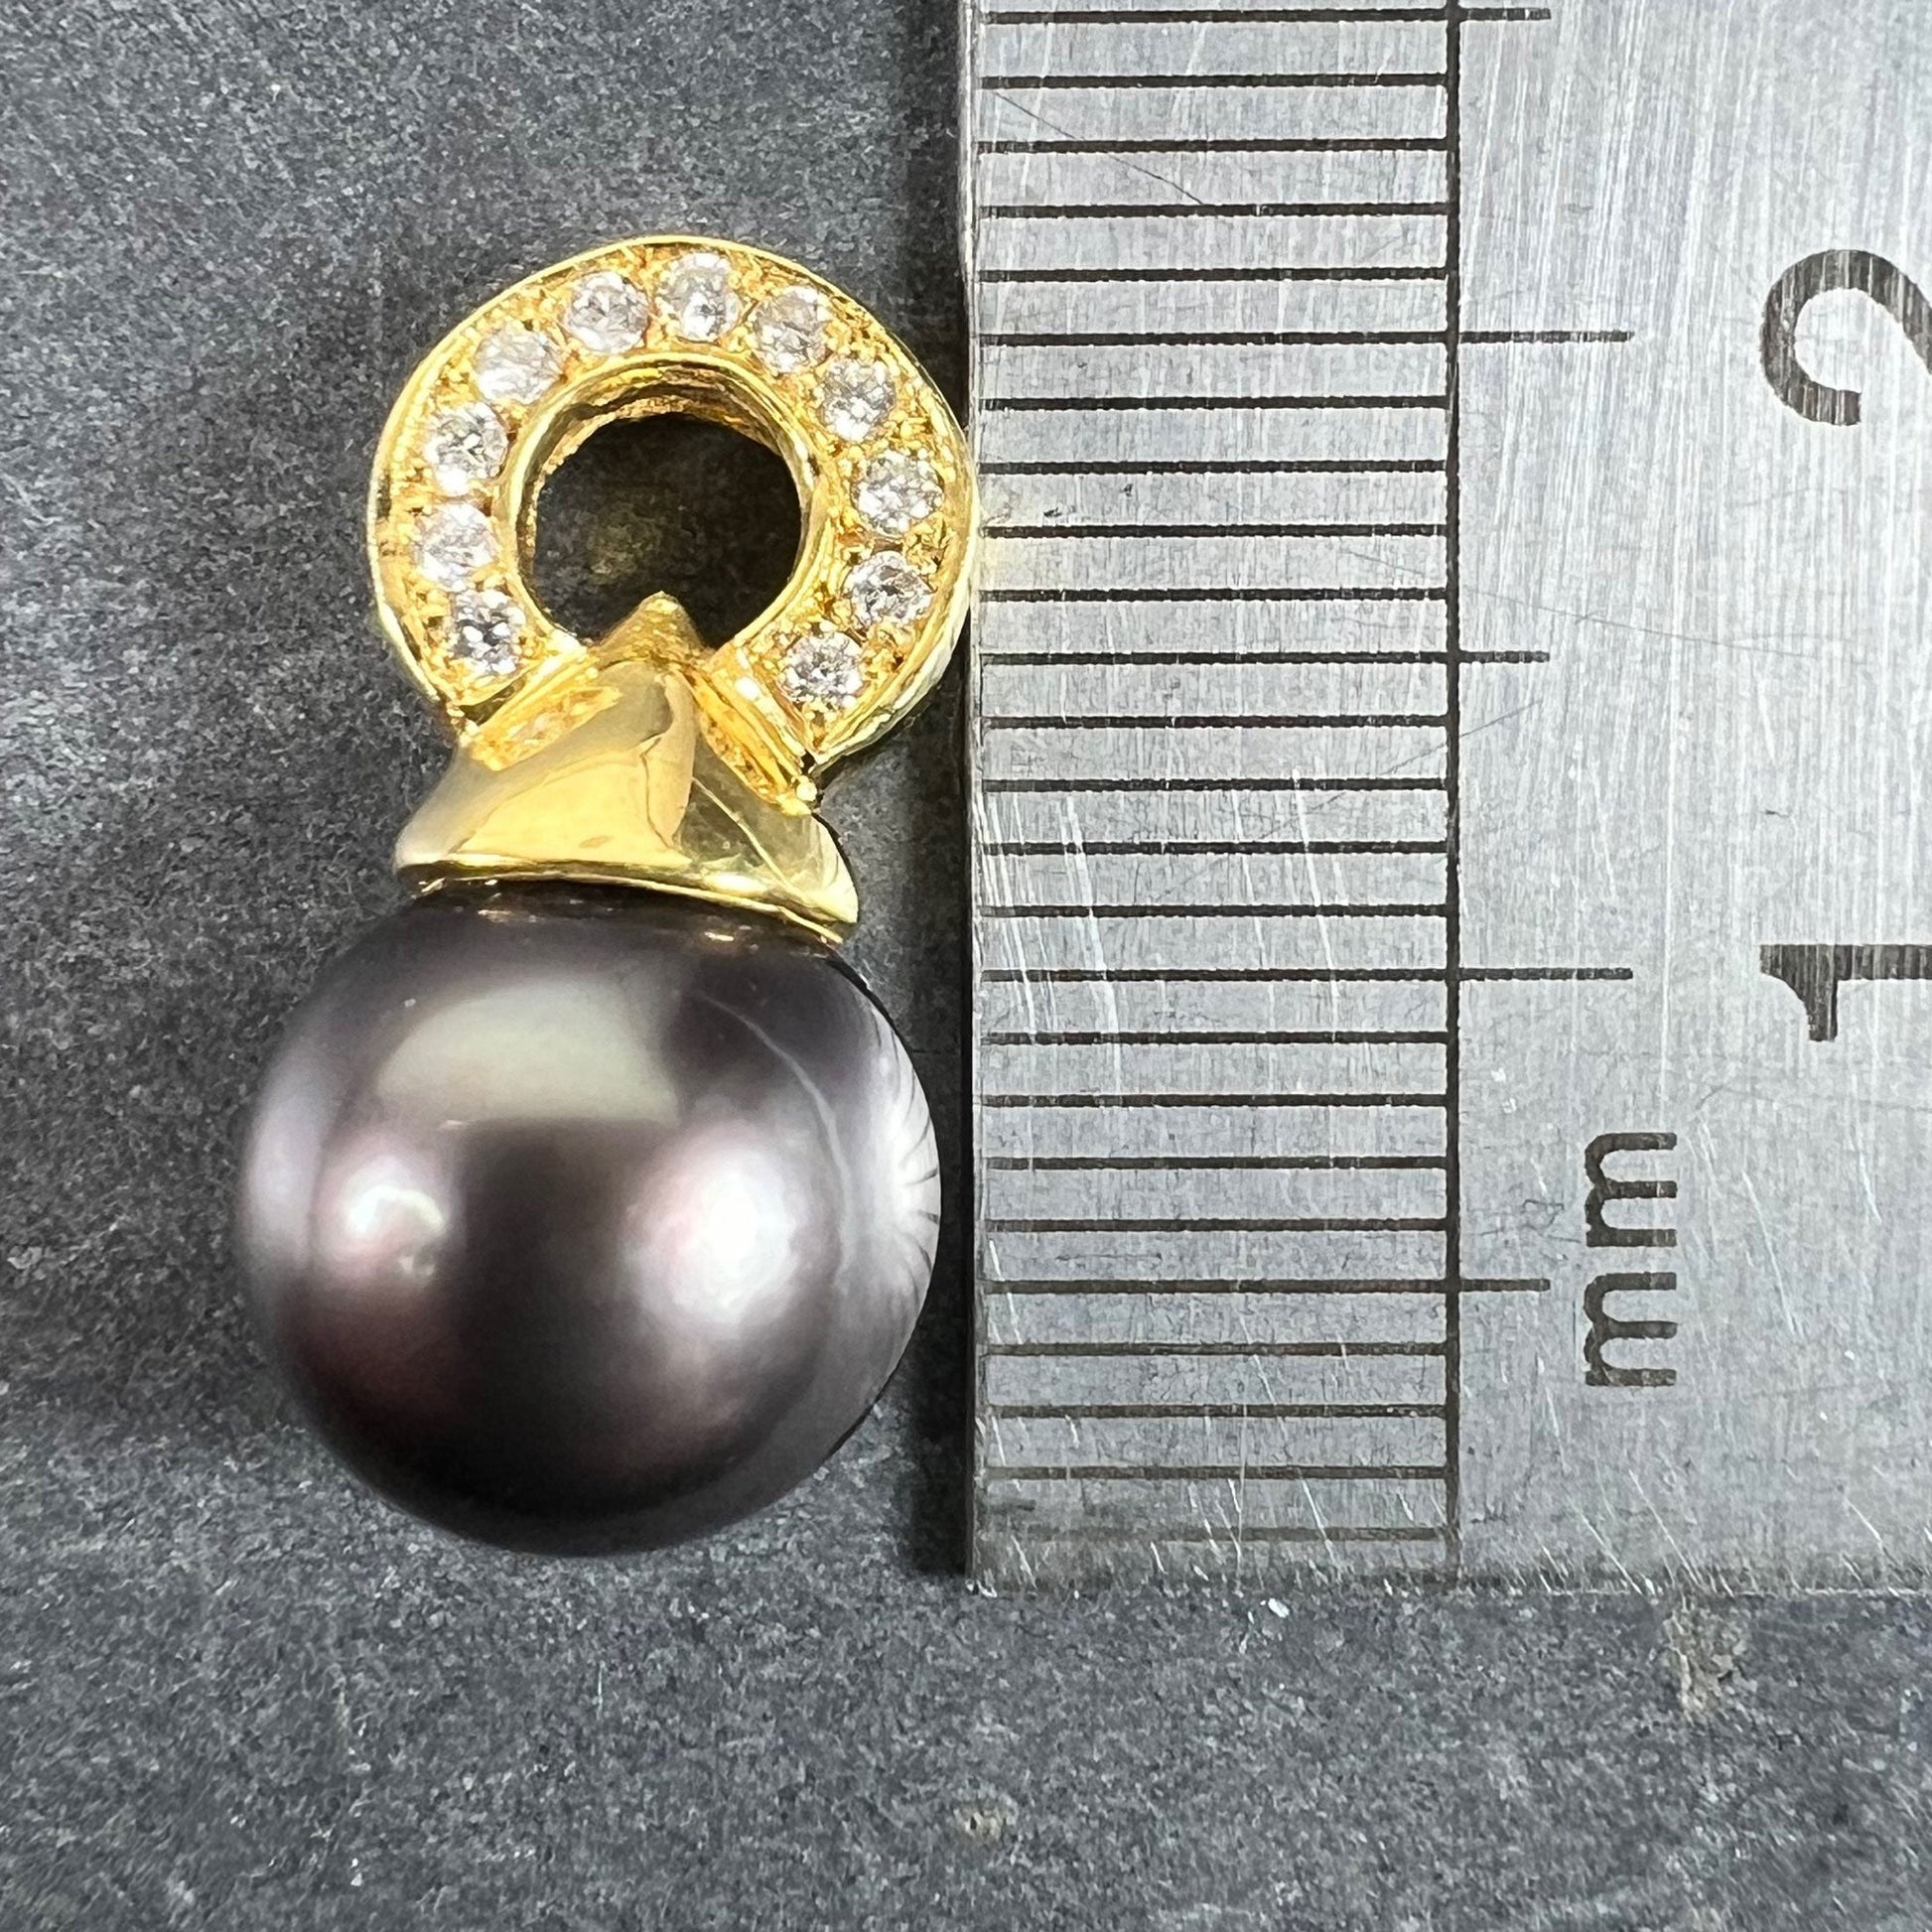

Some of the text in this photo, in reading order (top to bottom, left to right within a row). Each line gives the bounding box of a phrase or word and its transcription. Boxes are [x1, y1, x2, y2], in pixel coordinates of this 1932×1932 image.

[1760, 249, 1932, 426] 2
[1759, 944, 1932, 1041] 1
[1584, 1132, 1677, 1387] mm
